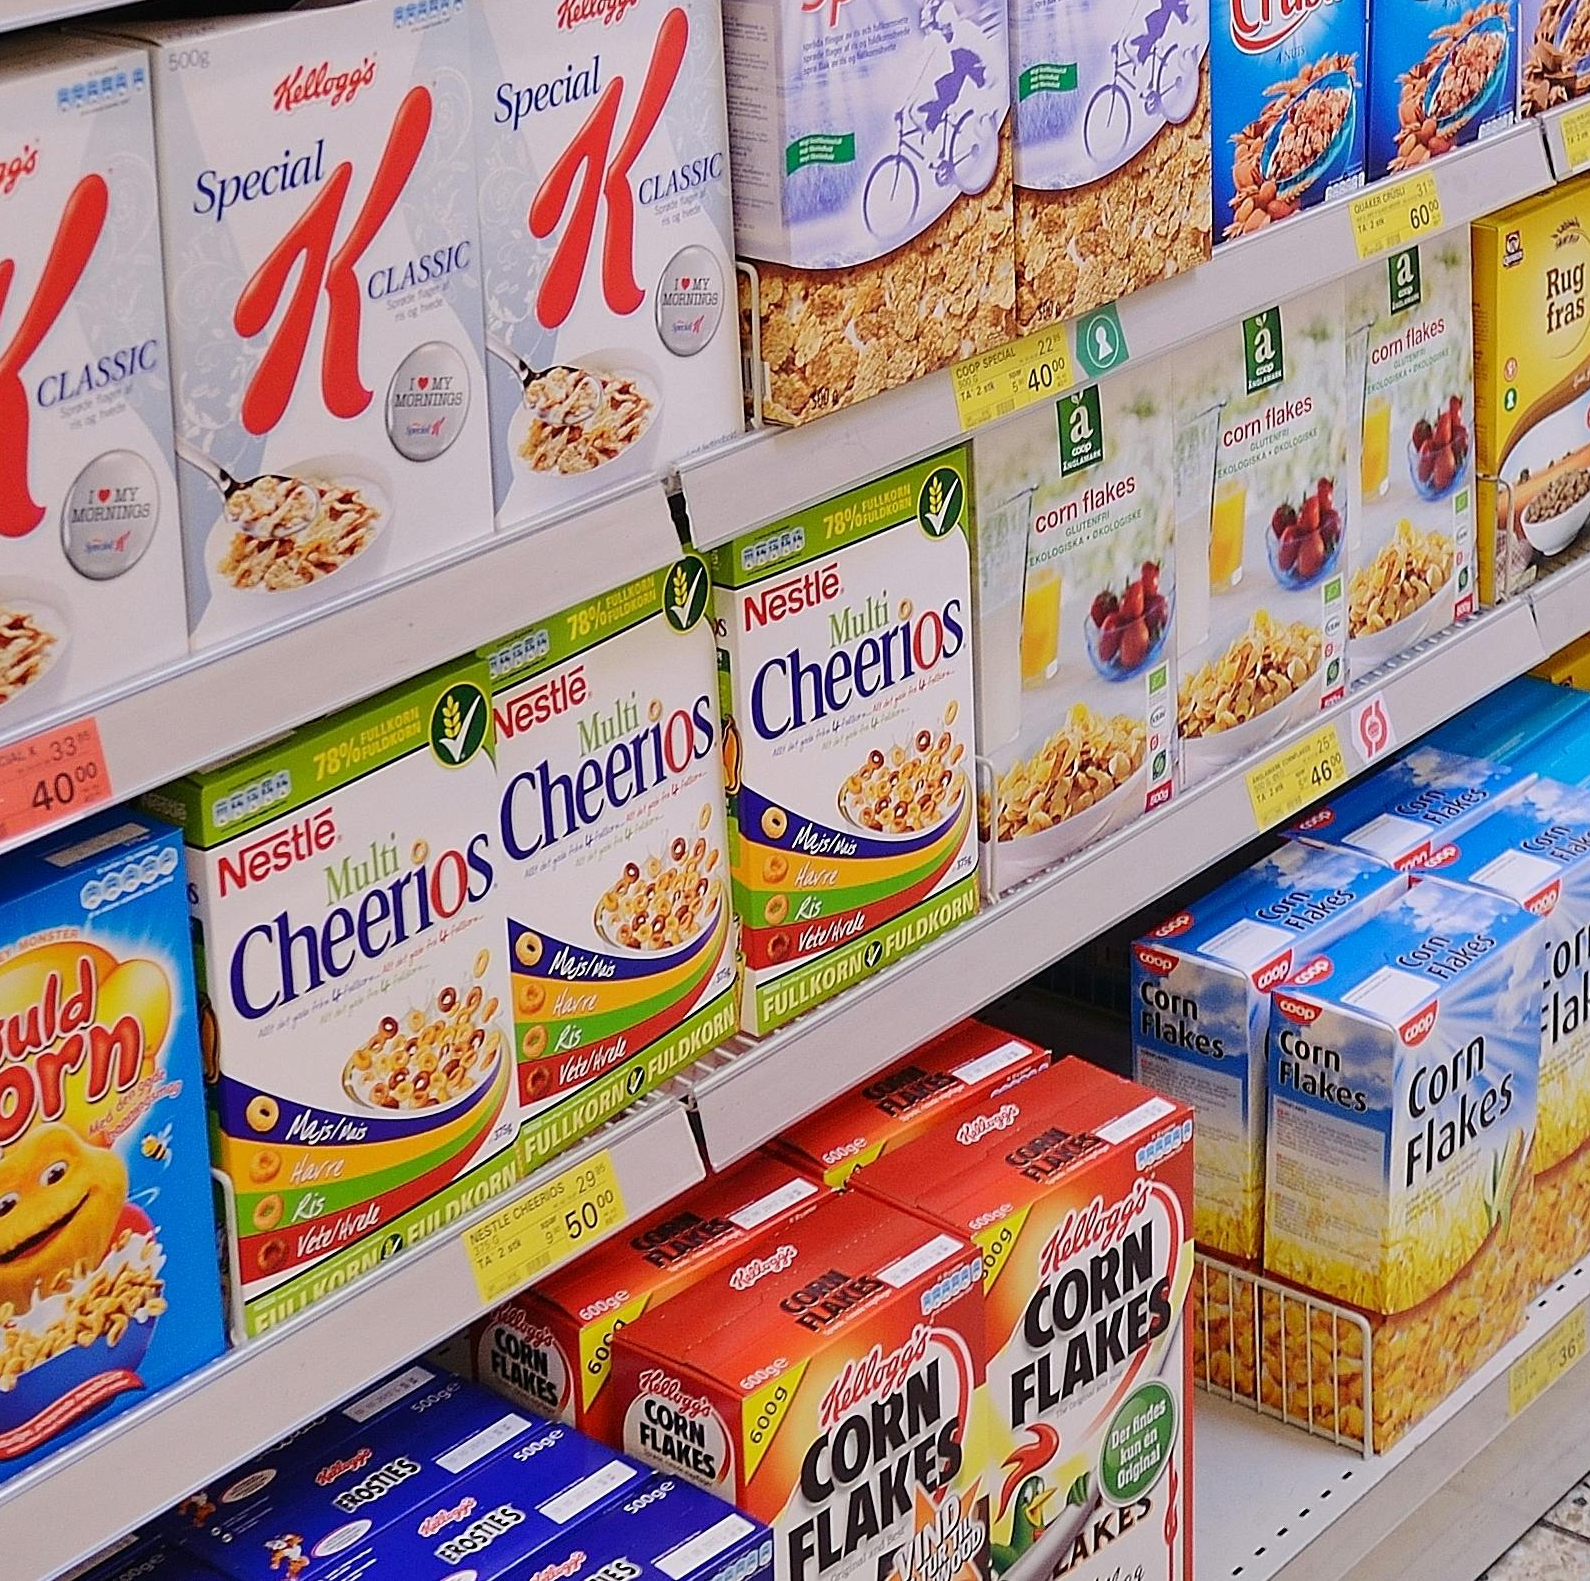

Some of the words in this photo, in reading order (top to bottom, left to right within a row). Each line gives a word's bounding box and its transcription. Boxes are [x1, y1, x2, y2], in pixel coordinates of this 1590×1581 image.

[527, 6, 689, 329] K
[638, 151, 723, 208] CLASSIC
[232, 85, 434, 436] K
[367, 240, 471, 300] CLASSIC
[1544, 260, 1586, 301] Rug
[1545, 297, 1586, 336] fras
[37, 337, 159, 412] CLASSIC
[955, 361, 980, 379] COOP
[982, 347, 1017, 369] SPECIAL
[394, 392, 463, 408] MORNINGS
[1223, 418, 1262, 448] corn
[1264, 395, 1314, 430] flakes
[71, 498, 152, 526] MORNINGS
[860, 479, 912, 512] FULLKORN
[862, 497, 913, 529] FULDKORN
[1035, 501, 1078, 535] corn
[1082, 473, 1137, 513] flakes
[823, 507, 864, 541] 78%
[1065, 511, 1110, 538] GLUTENFRI
[744, 562, 842, 632] Nestlé
[827, 591, 890, 648] Multi
[750, 599, 965, 743] Cheerios
[357, 704, 420, 747] FULLKORN
[357, 725, 422, 766] FULDKORN
[577, 691, 640, 754] Multi
[311, 741, 361, 783] 78%
[501, 697, 715, 861] Cheerios
[216, 806, 337, 897] Nestlé
[324, 833, 399, 908] Multi
[229, 832, 495, 1022] Cheerios
[1140, 980, 1199, 1022] Corn
[1279, 1028, 1342, 1074] Corn
[1278, 1061, 1369, 1115] Flakes
[291, 1154, 345, 1181] Havre
[293, 1192, 326, 1220] Ris
[469, 1213, 511, 1245] NESTLE
[512, 1181, 565, 1220] CHEERIOS
[1009, 1276, 1175, 1429] FLAKES
[644, 1398, 706, 1445] CORN
[1111, 1428, 1131, 1450] Der
[1132, 1398, 1167, 1438] findes
[639, 1425, 716, 1481] FLAKES
[1117, 1443, 1161, 1490] Original
[333, 1455, 423, 1514] FROSTIES
